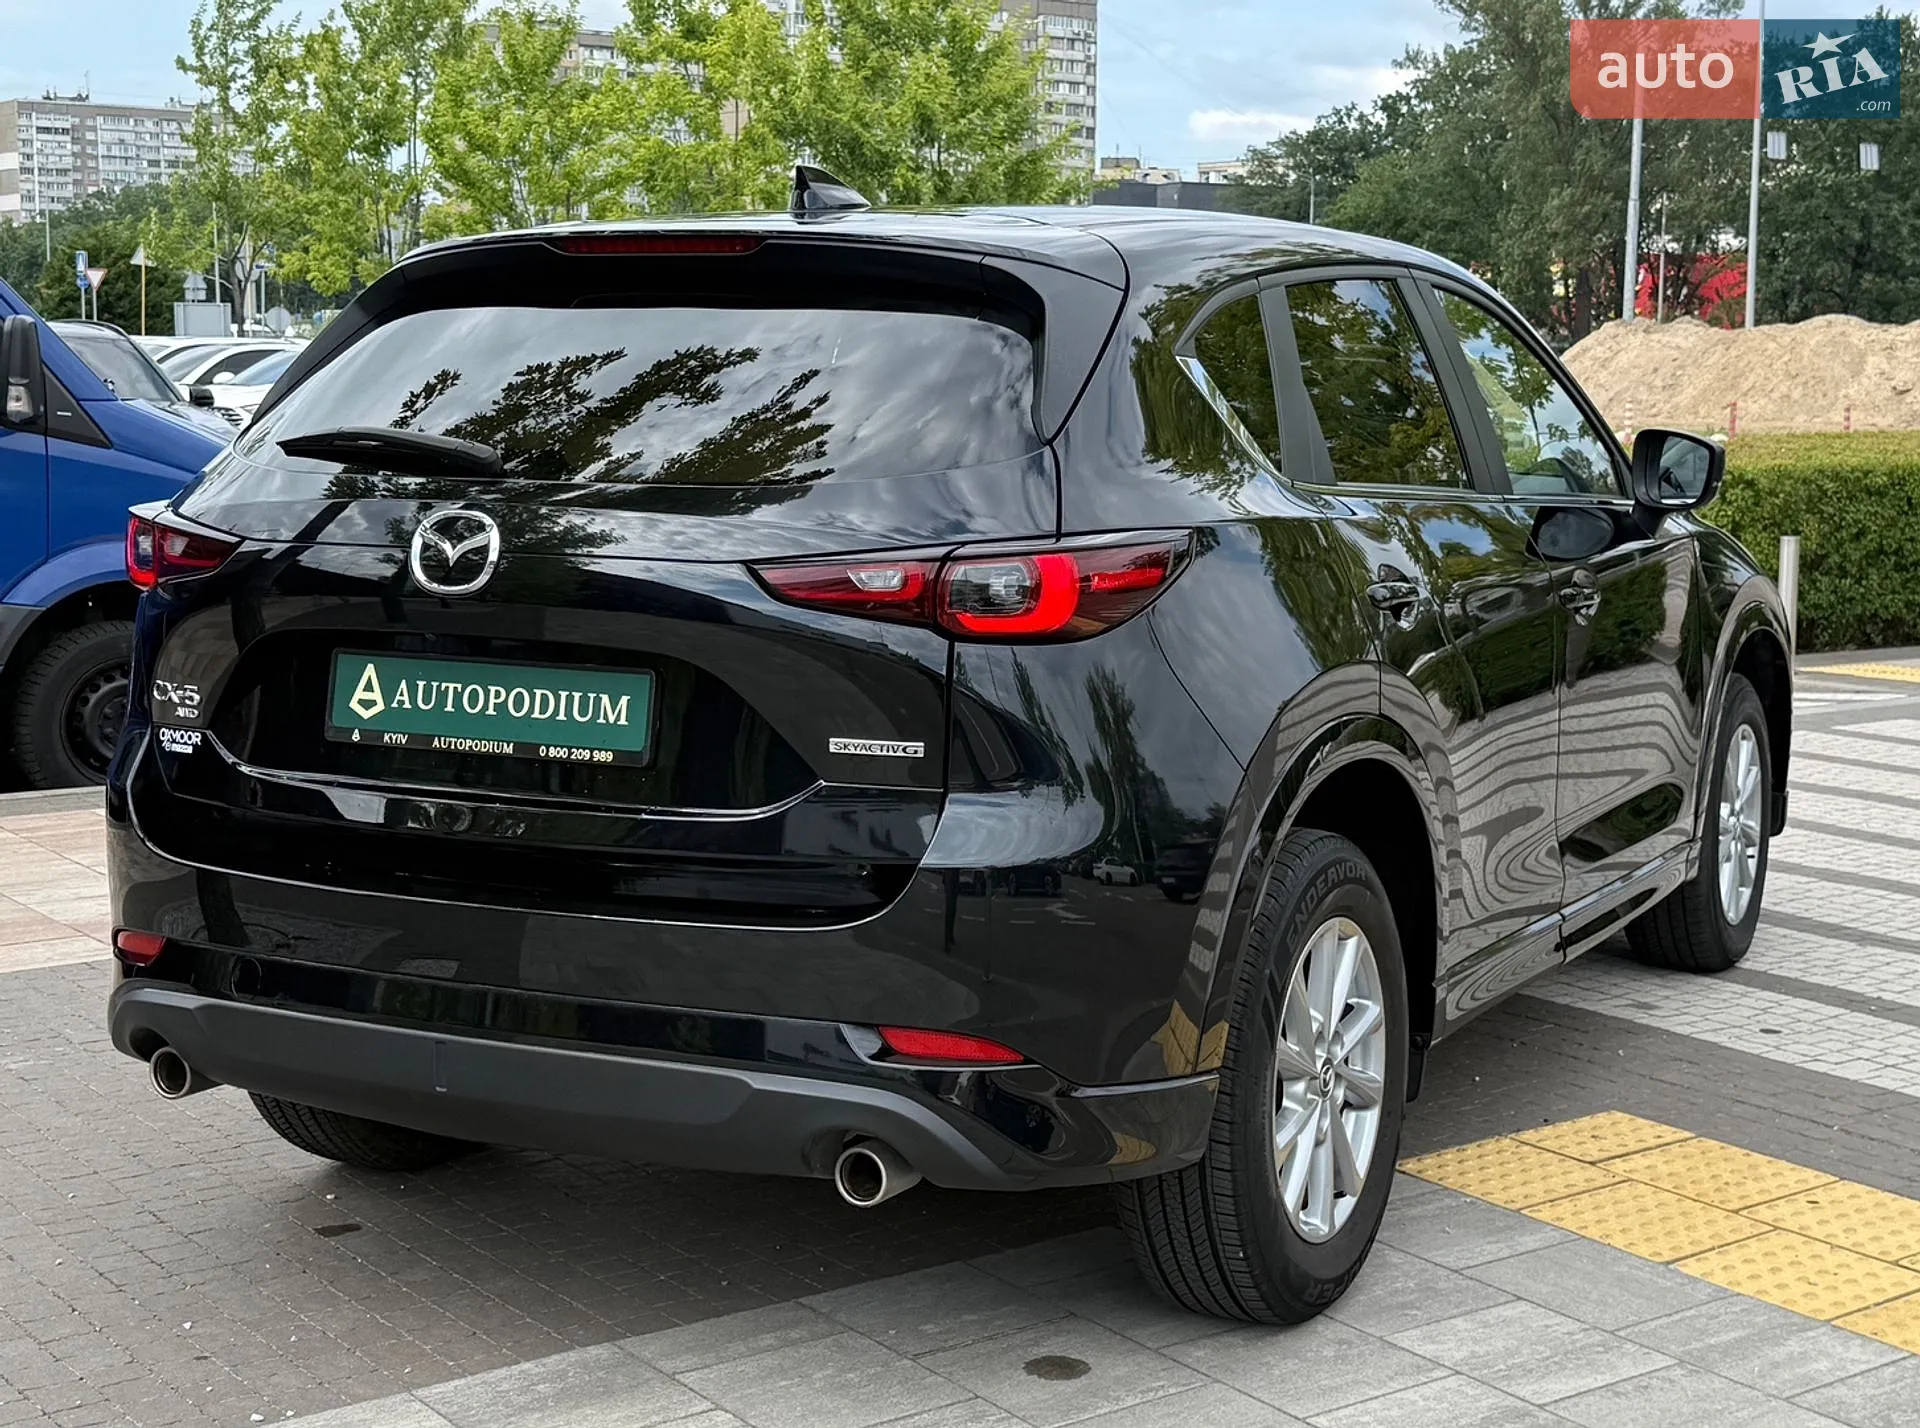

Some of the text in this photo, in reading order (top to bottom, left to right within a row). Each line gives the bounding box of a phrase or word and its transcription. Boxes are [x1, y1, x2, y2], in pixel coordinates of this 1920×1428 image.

[153, 680, 200, 706] CX-5
[390, 678, 631, 726] AUTOPODIUM
[159, 727, 202, 747] OXMOOR
[383, 732, 614, 763] KYIV AUTOPODIUM 0 800 209 989
[1286, 861, 1368, 954] ENDEAVOR
